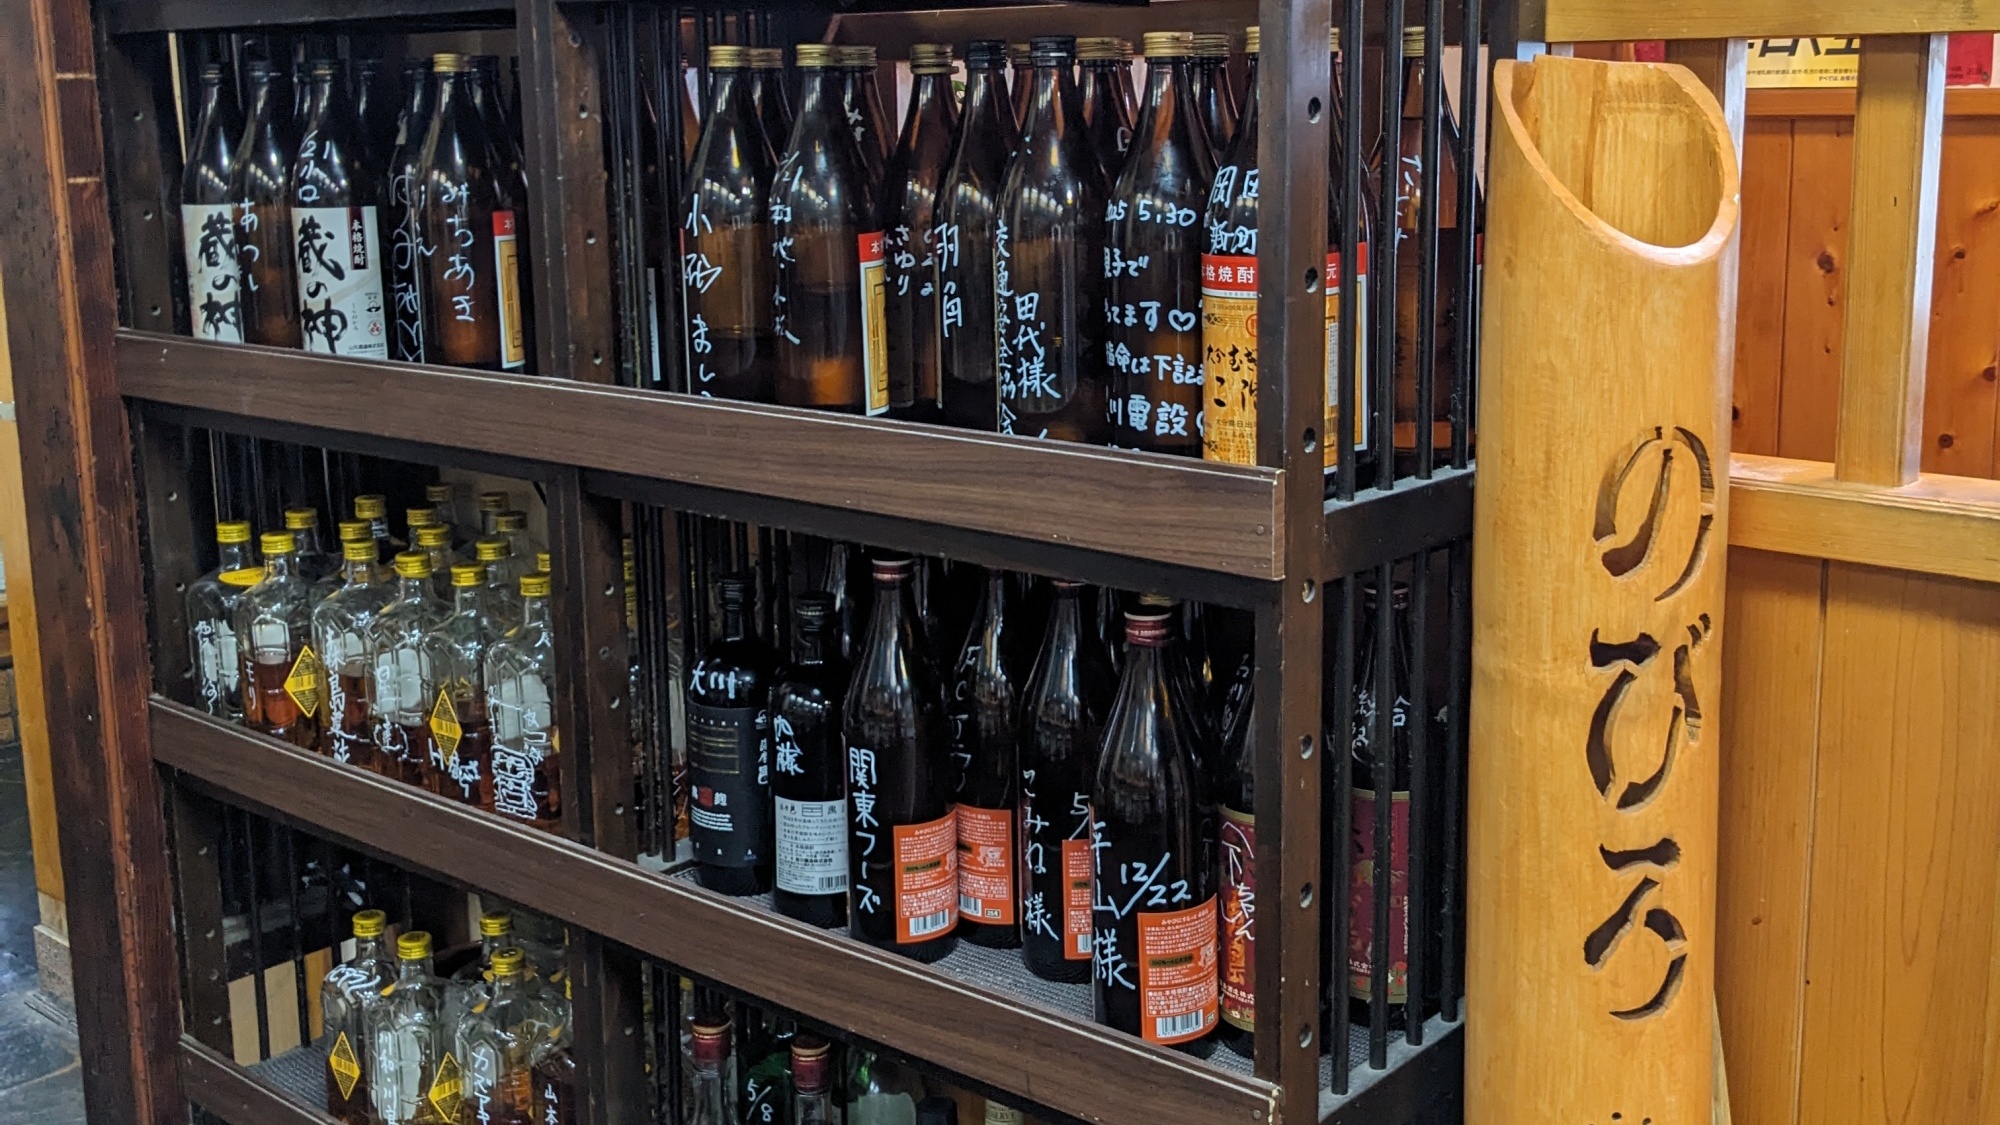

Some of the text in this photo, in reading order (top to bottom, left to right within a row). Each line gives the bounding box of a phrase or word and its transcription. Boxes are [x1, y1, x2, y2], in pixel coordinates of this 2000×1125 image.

[298, 213, 348, 355] 蔵の神
[351, 219, 366, 267] 本格焼酎
[894, 224, 916, 296] さゆり
[1011, 292, 1062, 399] 田代様
[1583, 424, 1716, 1019] のびろ
[850, 747, 881, 914] 関東フーズ
[1120, 852, 1192, 917] 12/22
[745, 1077, 775, 1123] 5/8
